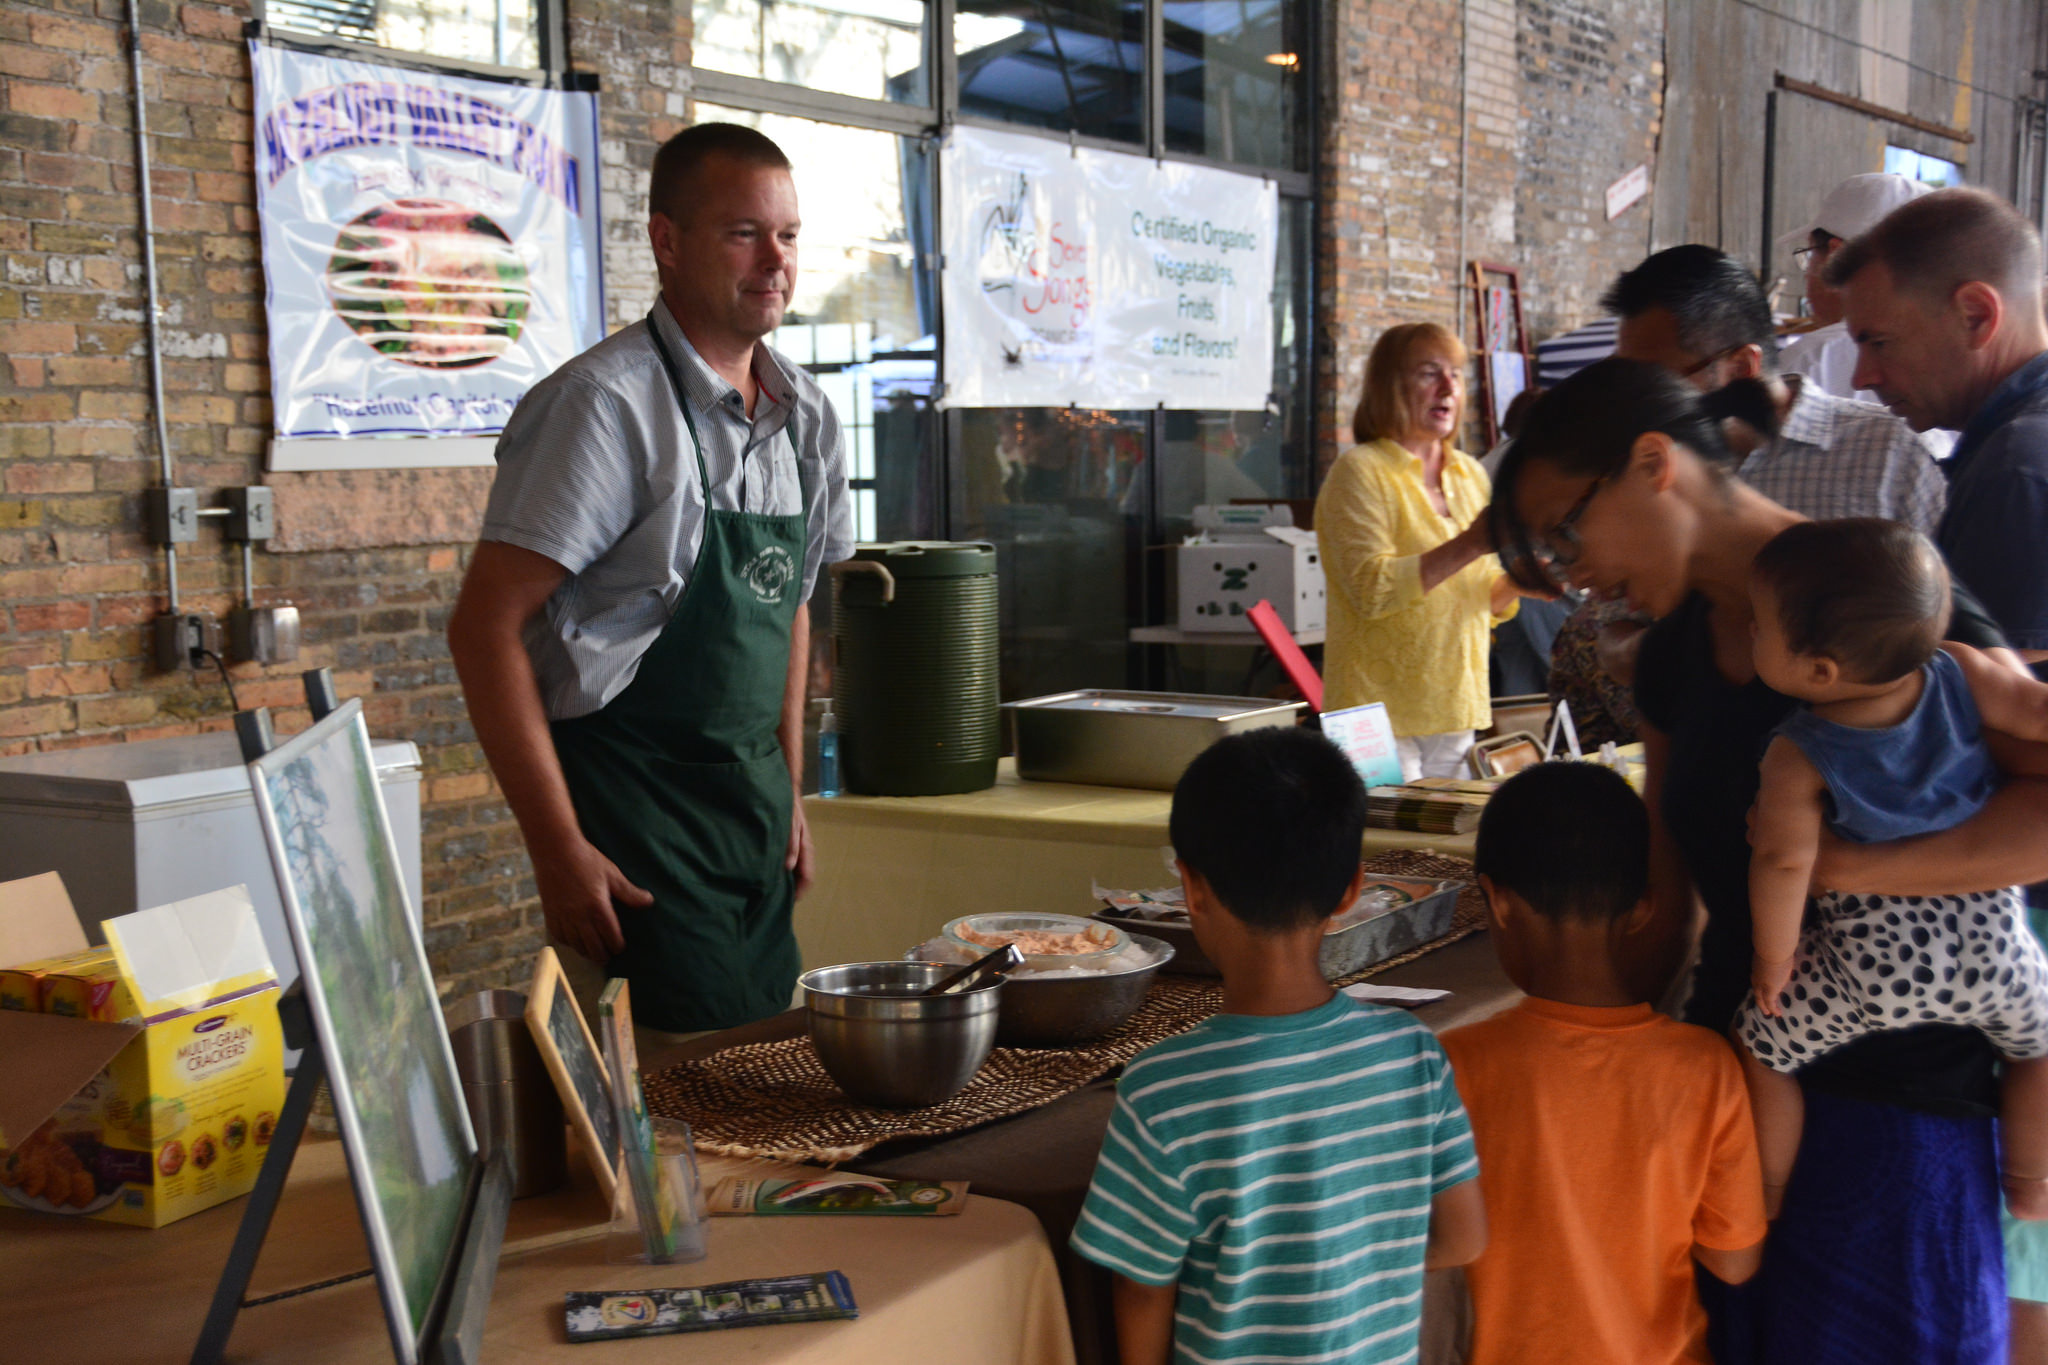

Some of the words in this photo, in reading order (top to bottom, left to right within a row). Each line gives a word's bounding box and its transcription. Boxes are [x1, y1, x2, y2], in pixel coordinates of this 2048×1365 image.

[1133, 211, 1197, 243] Certified
[1202, 221, 1256, 253] Organic
[1152, 333, 1181, 356] and
[1185, 332, 1238, 359] Flavors!
[178, 1027, 253, 1060] MULTI-GRAIN
[188, 1042, 246, 1071] CRACKERS
